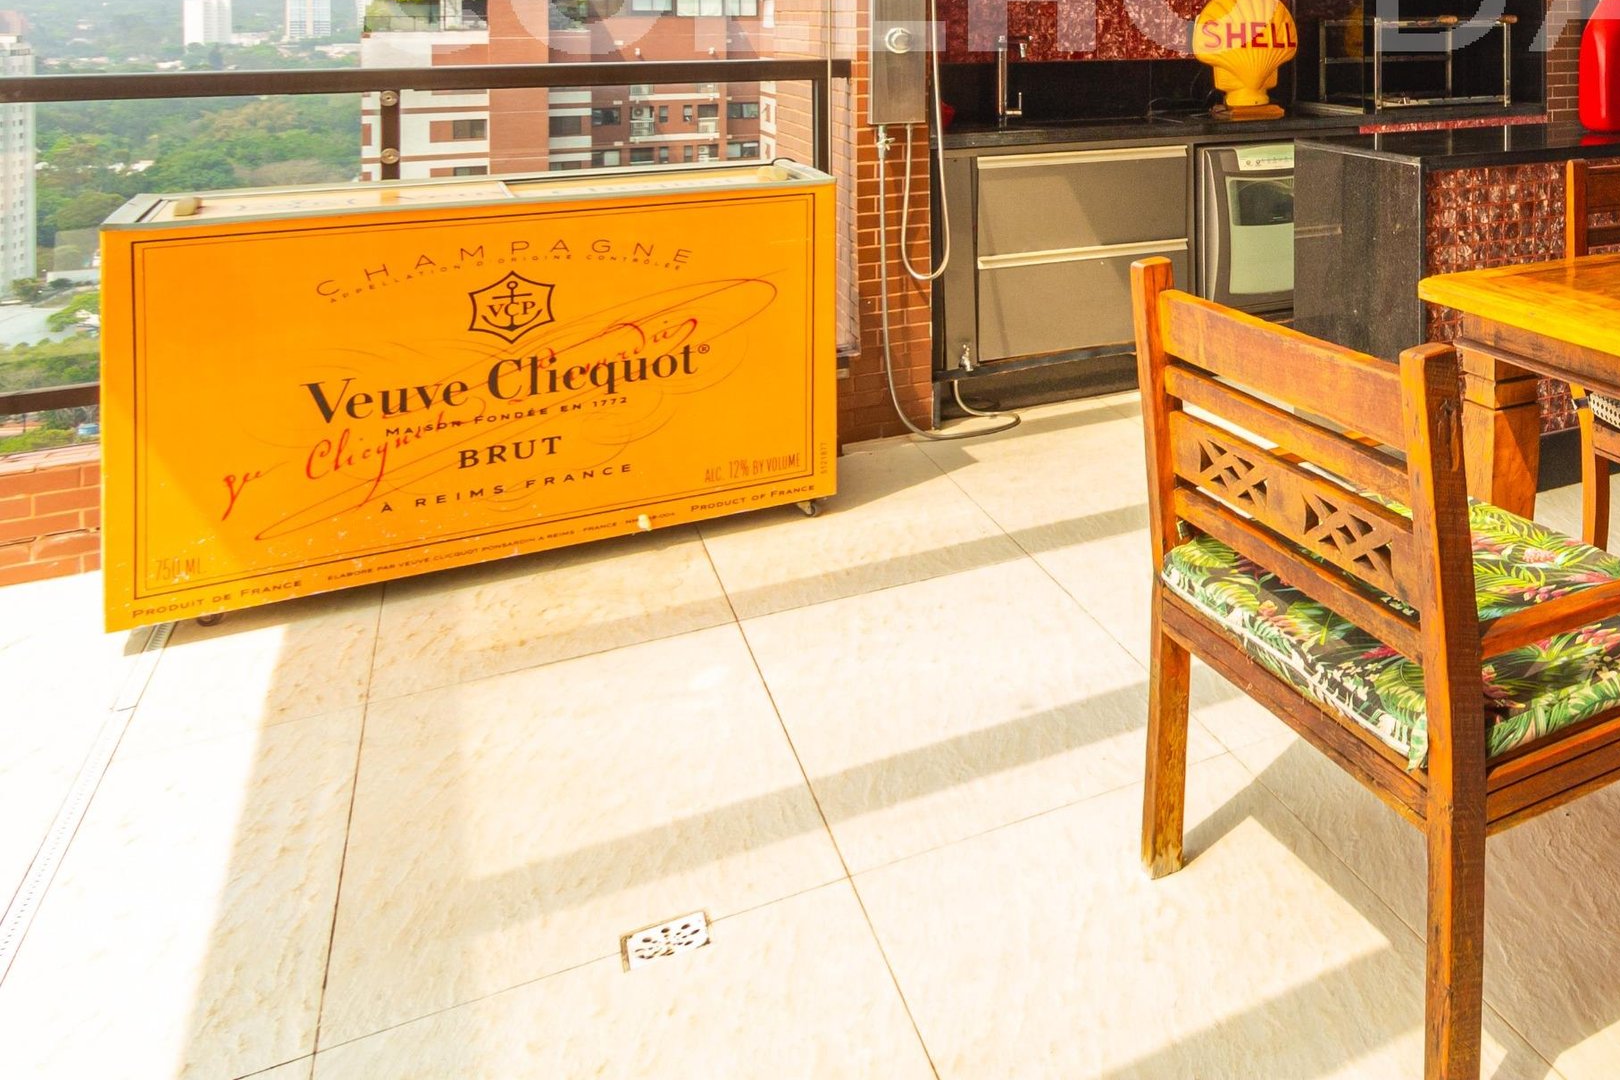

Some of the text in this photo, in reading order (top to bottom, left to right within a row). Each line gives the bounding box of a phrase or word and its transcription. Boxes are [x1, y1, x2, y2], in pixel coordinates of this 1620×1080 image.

[1202, 19, 1297, 49] SHELL
[316, 238, 693, 297] CHAMPAGNE
[299, 377, 469, 424] Veuve
[385, 420, 463, 437] MAISON
[560, 403, 582, 413] EN
[593, 396, 627, 408] 1772
[457, 435, 563, 470] BRUT
[729, 458, 749, 479] 12%
[752, 459, 763, 476] BY
[766, 452, 801, 473] VOLUME
[415, 484, 505, 508] REIMS
[525, 463, 632, 489] FRANCE
[690, 485, 815, 513] PRODUCT OF FRANCE
[132, 580, 303, 619] PRODUIT DE FRANCE
